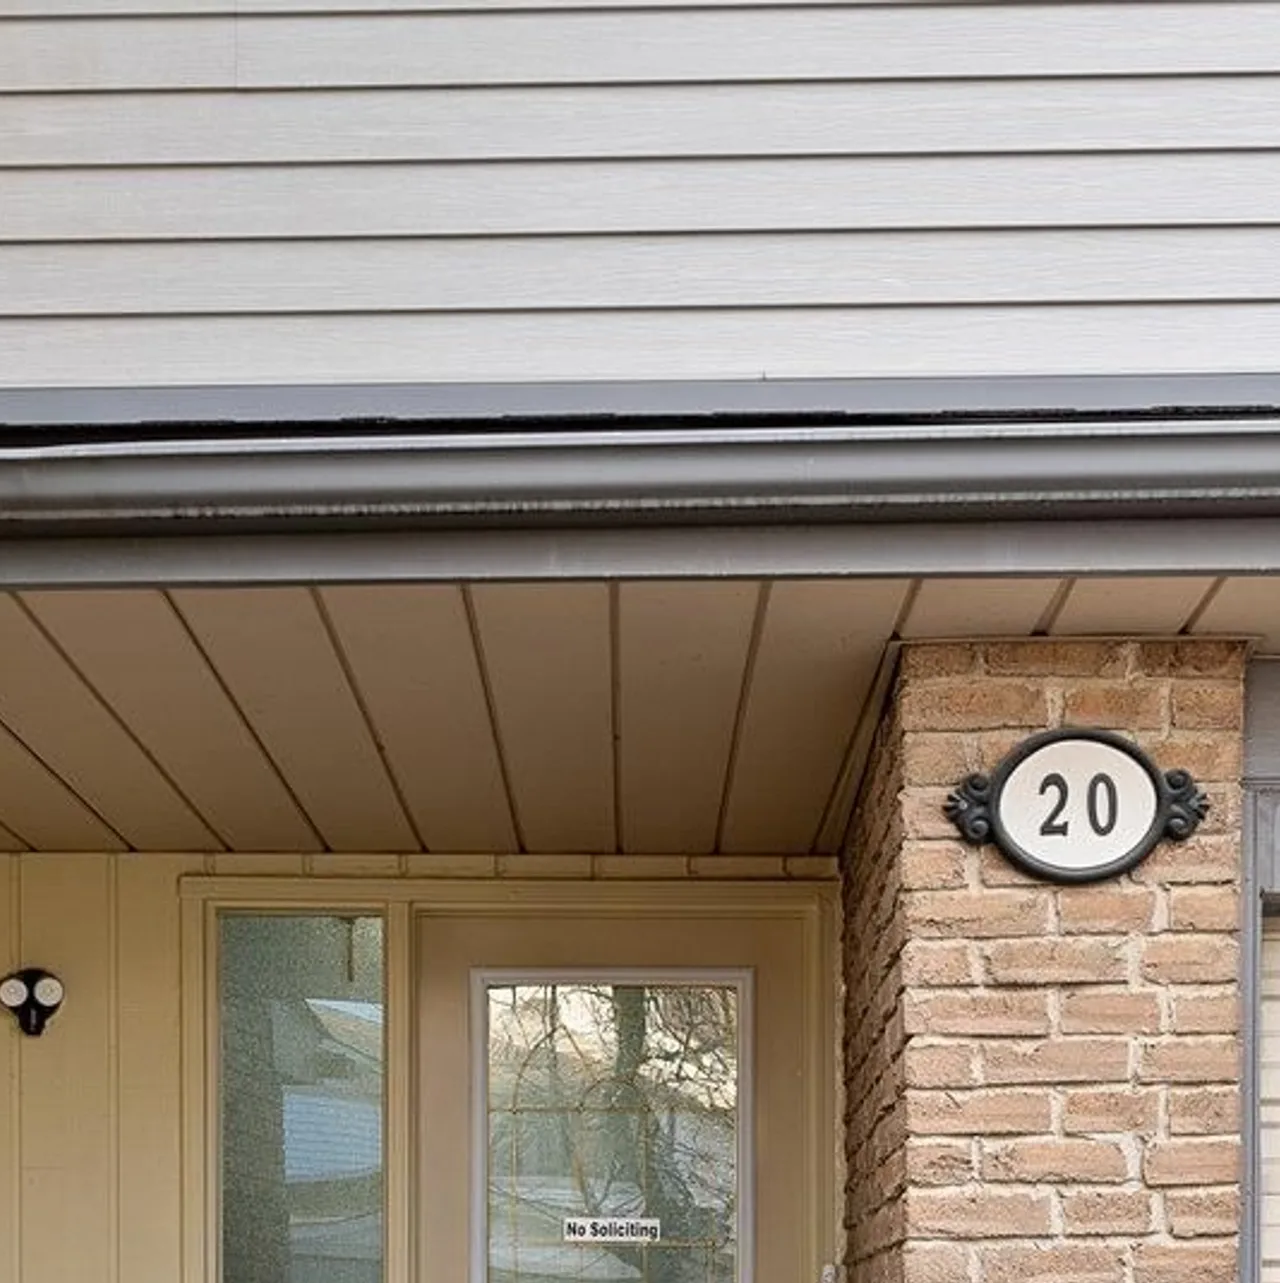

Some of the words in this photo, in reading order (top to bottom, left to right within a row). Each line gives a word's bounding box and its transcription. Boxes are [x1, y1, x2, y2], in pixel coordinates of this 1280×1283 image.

[1038, 772, 1118, 836] 20
[567, 1221, 586, 1237] No
[590, 1221, 658, 1240] Soliciting
